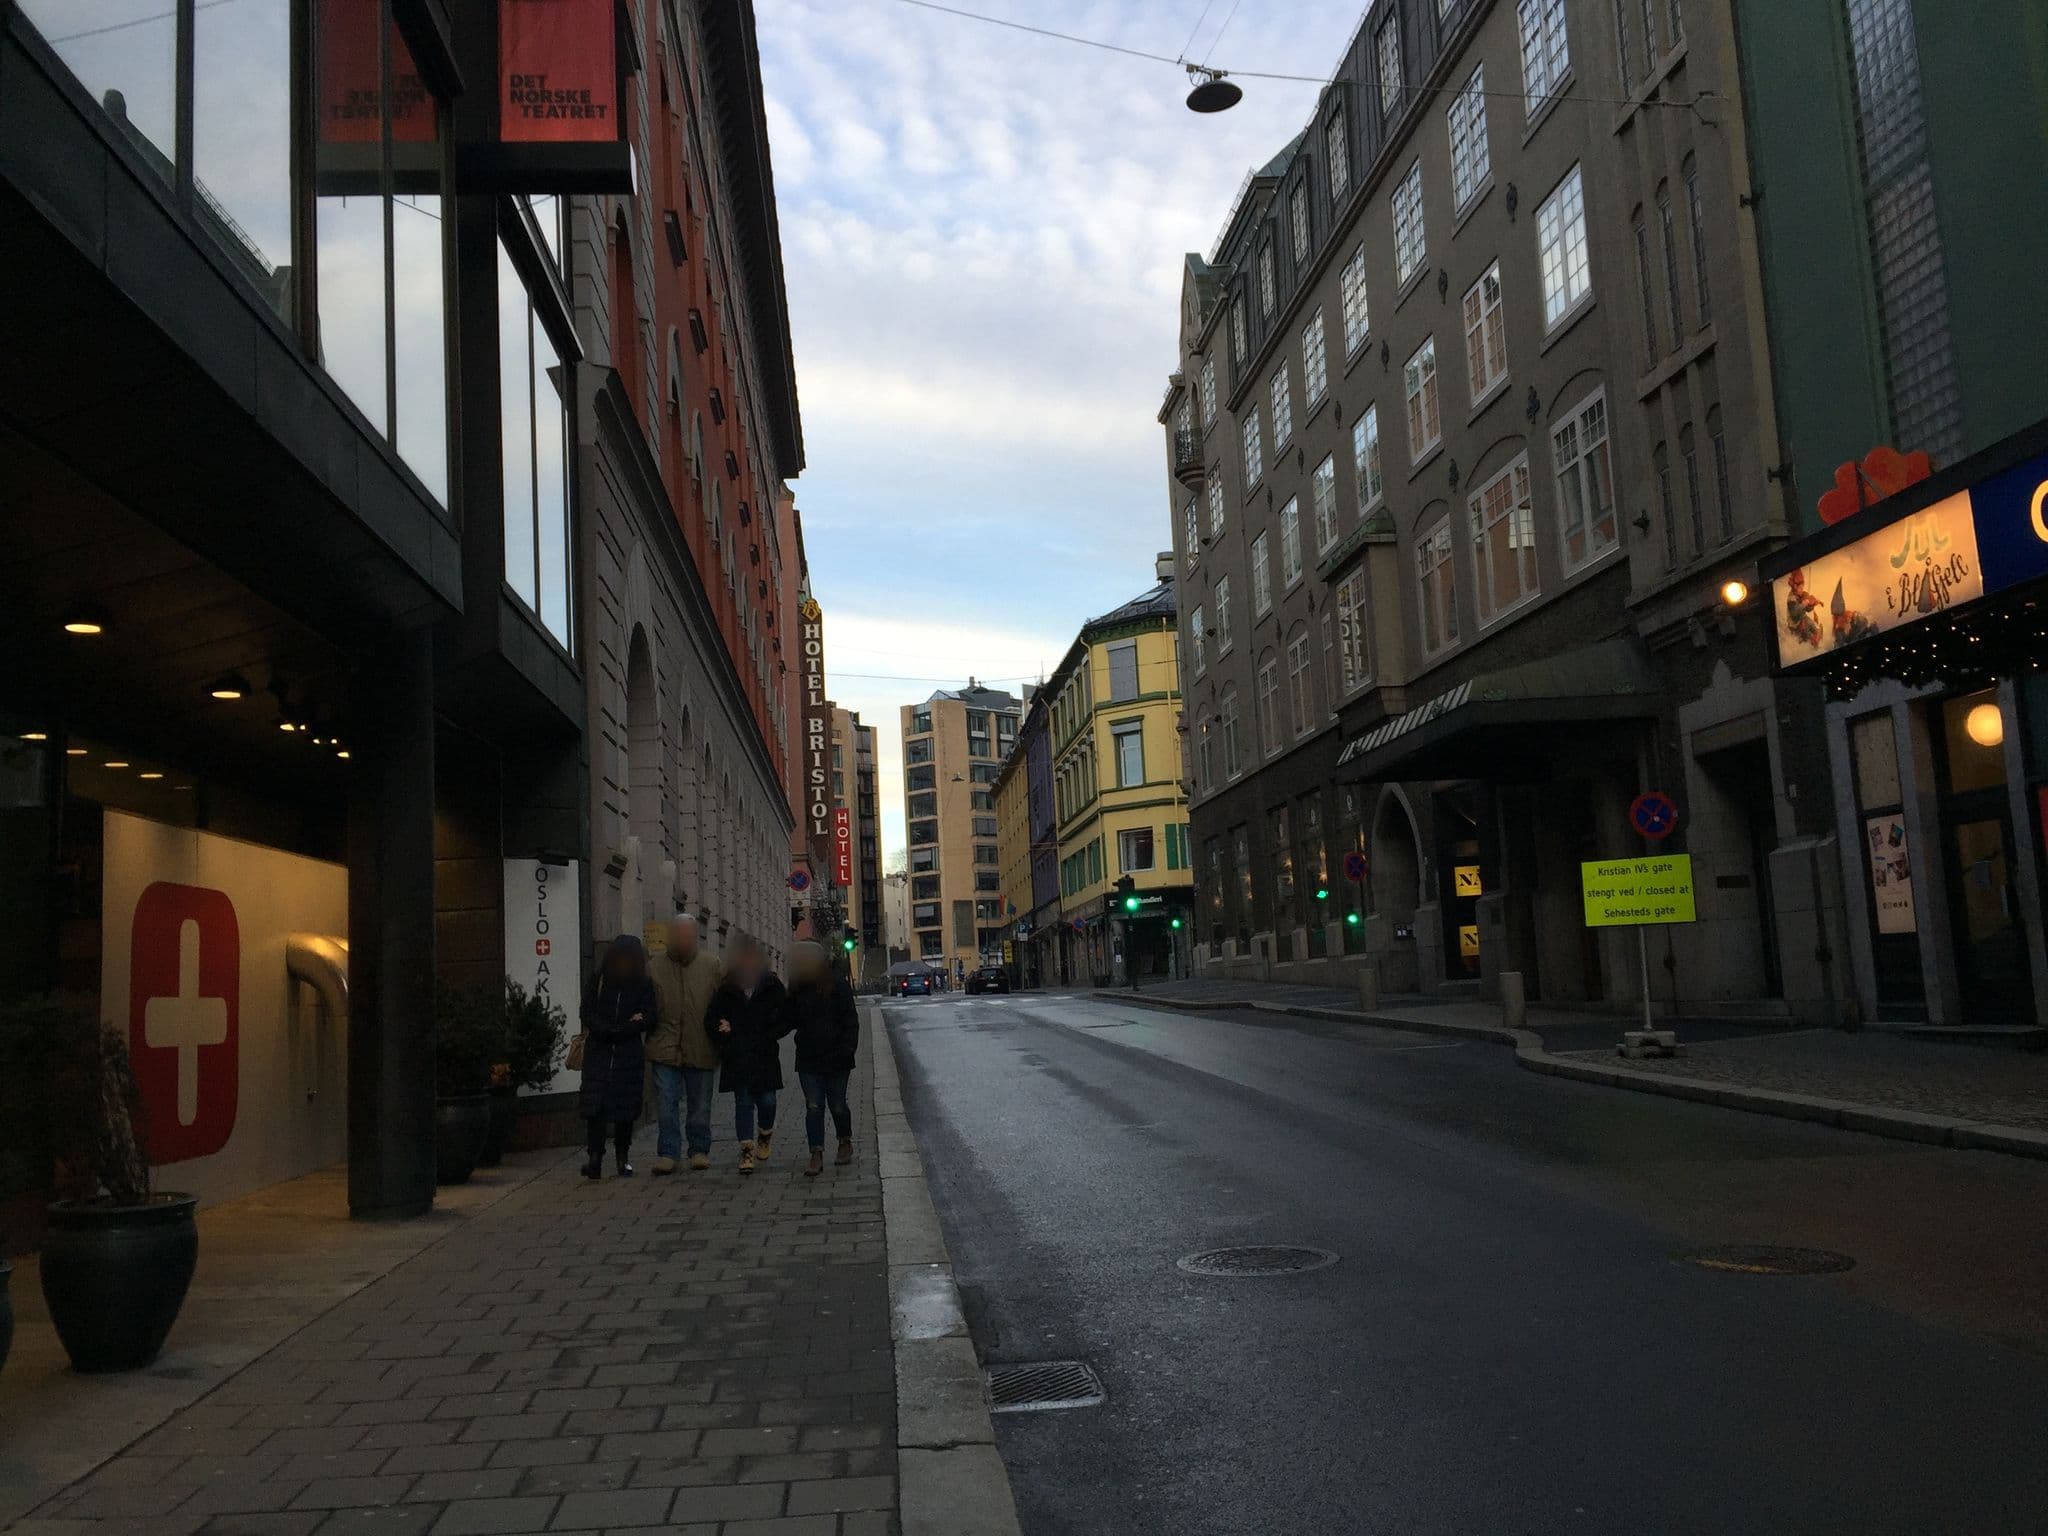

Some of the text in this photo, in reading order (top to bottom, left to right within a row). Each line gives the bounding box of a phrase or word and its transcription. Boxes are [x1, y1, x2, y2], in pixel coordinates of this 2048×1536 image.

[510, 74, 547, 89] DET
[510, 88, 592, 104] NORSKE
[520, 104, 607, 119] TEATRET
[804, 624, 828, 835] HOTEL BRISTOL
[837, 814, 848, 881] HOTEL
[1598, 866, 1631, 877] Kristian
[1652, 863, 1673, 875] gate
[1587, 888, 1615, 899] stengt
[1619, 887, 1634, 896] ved
[1645, 885, 1675, 896] closed
[1679, 886, 1689, 894] at
[534, 867, 549, 935] OSLO
[1604, 906, 1676, 918] Sehesteds gate
